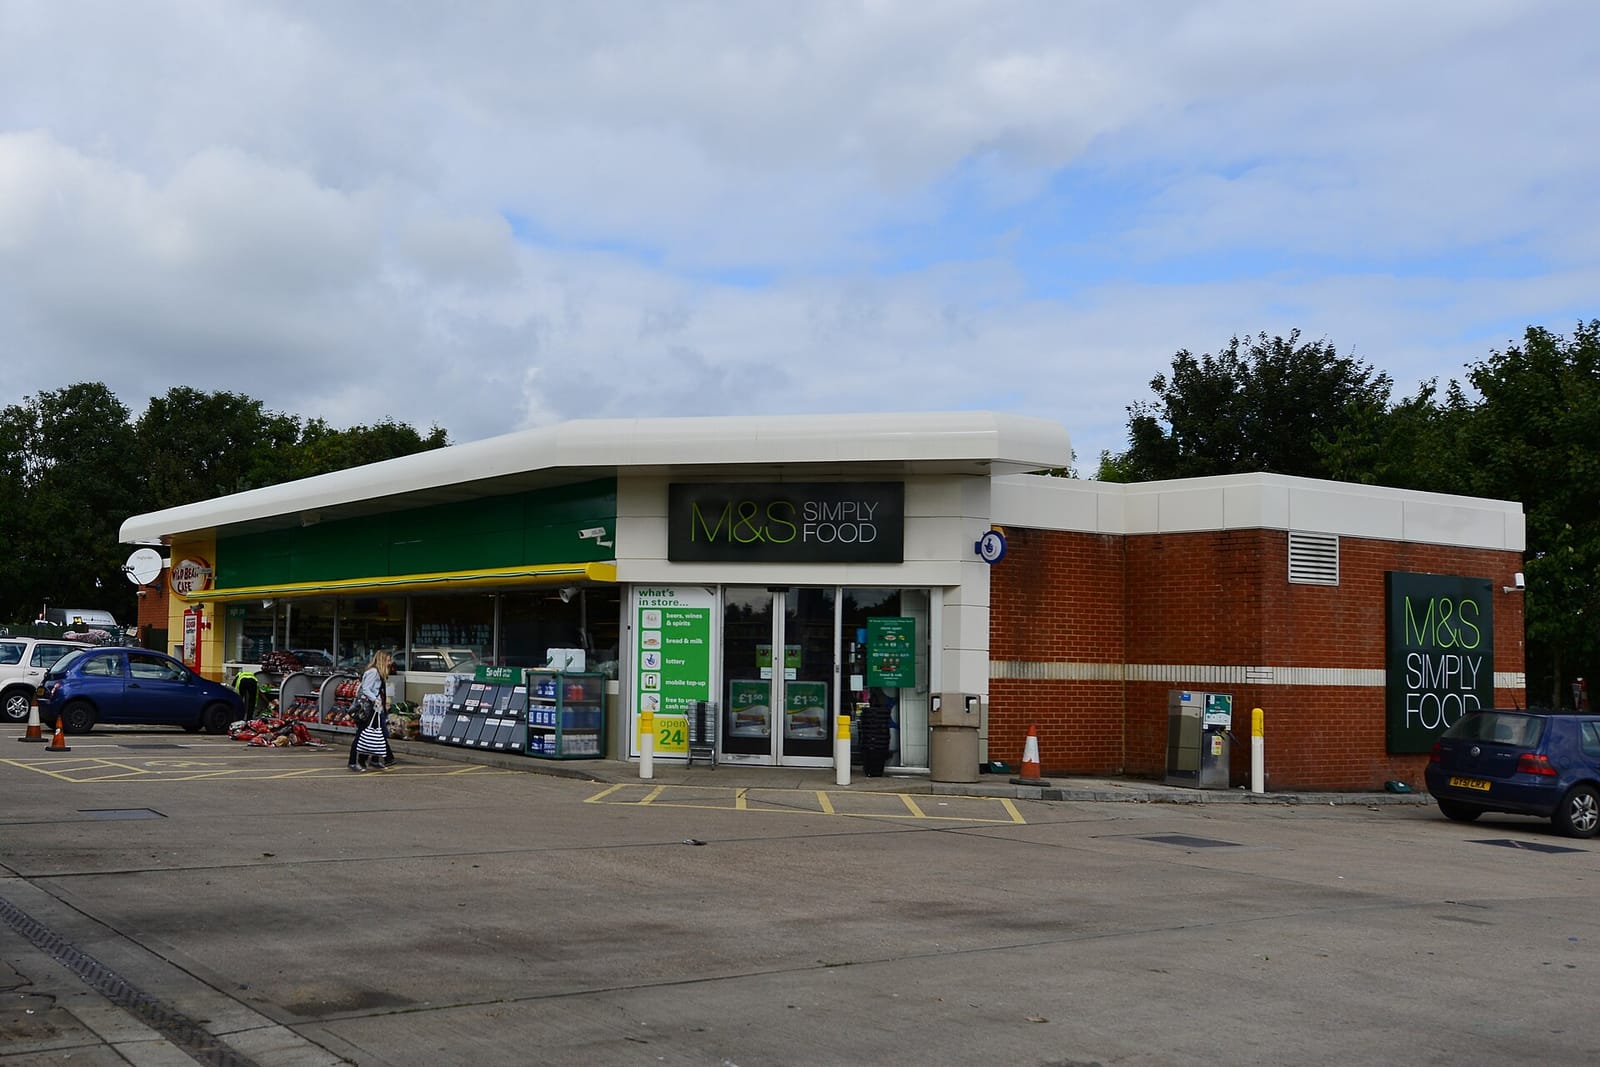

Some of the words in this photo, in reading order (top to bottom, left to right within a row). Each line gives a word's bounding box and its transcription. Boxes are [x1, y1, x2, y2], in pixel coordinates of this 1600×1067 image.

[803, 501, 879, 521] SIMPLY
[691, 501, 798, 543] M&S
[803, 523, 877, 544] FOOD
[639, 589, 675, 597] what's
[639, 598, 648, 606] in
[1405, 596, 1480, 649] M&S
[666, 658, 685, 666] lottery
[1406, 652, 1482, 689] SIMPLY
[660, 720, 686, 729] open
[660, 730, 684, 745] 24
